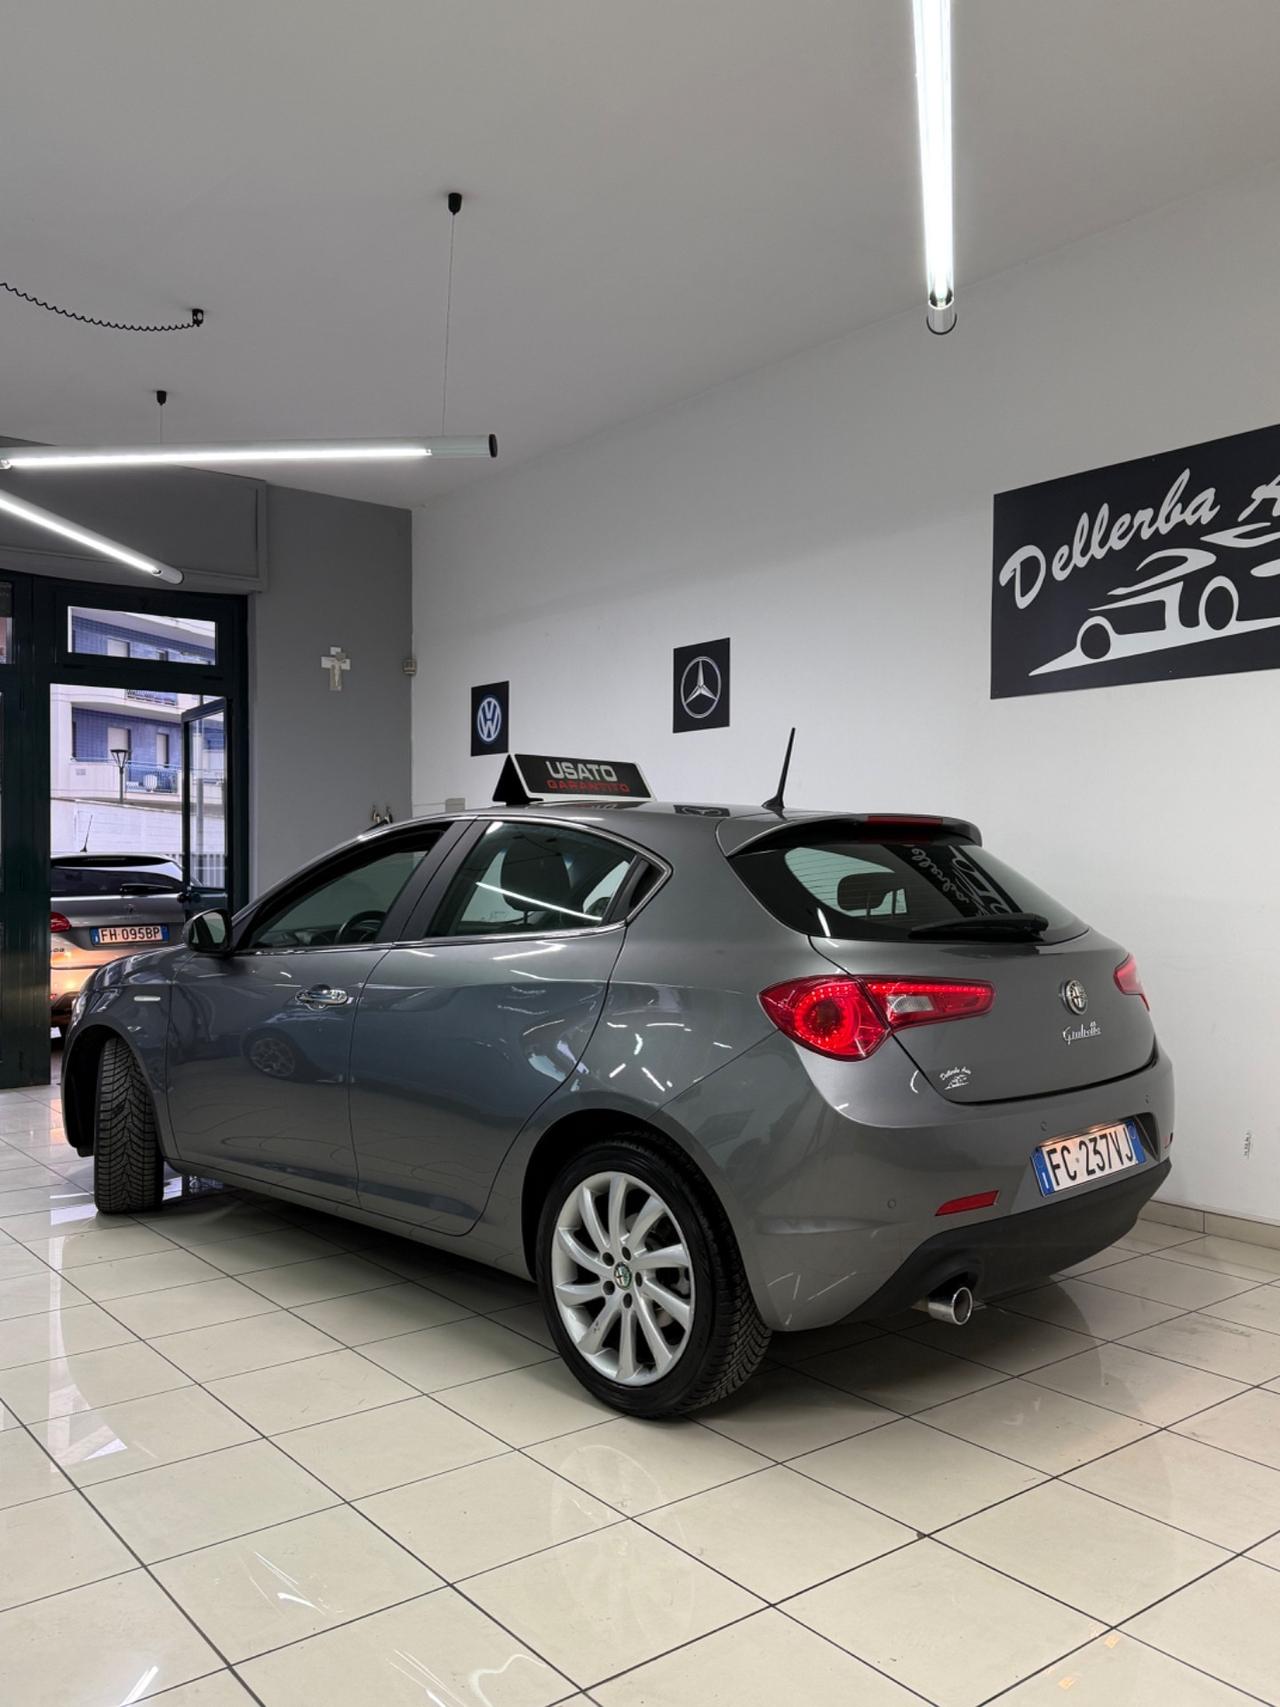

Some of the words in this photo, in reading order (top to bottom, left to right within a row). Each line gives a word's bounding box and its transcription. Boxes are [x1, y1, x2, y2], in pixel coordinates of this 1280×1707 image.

[999, 468, 1220, 609] Dellerba
[545, 761, 618, 782] USATO
[545, 780, 630, 794] GARANTITO
